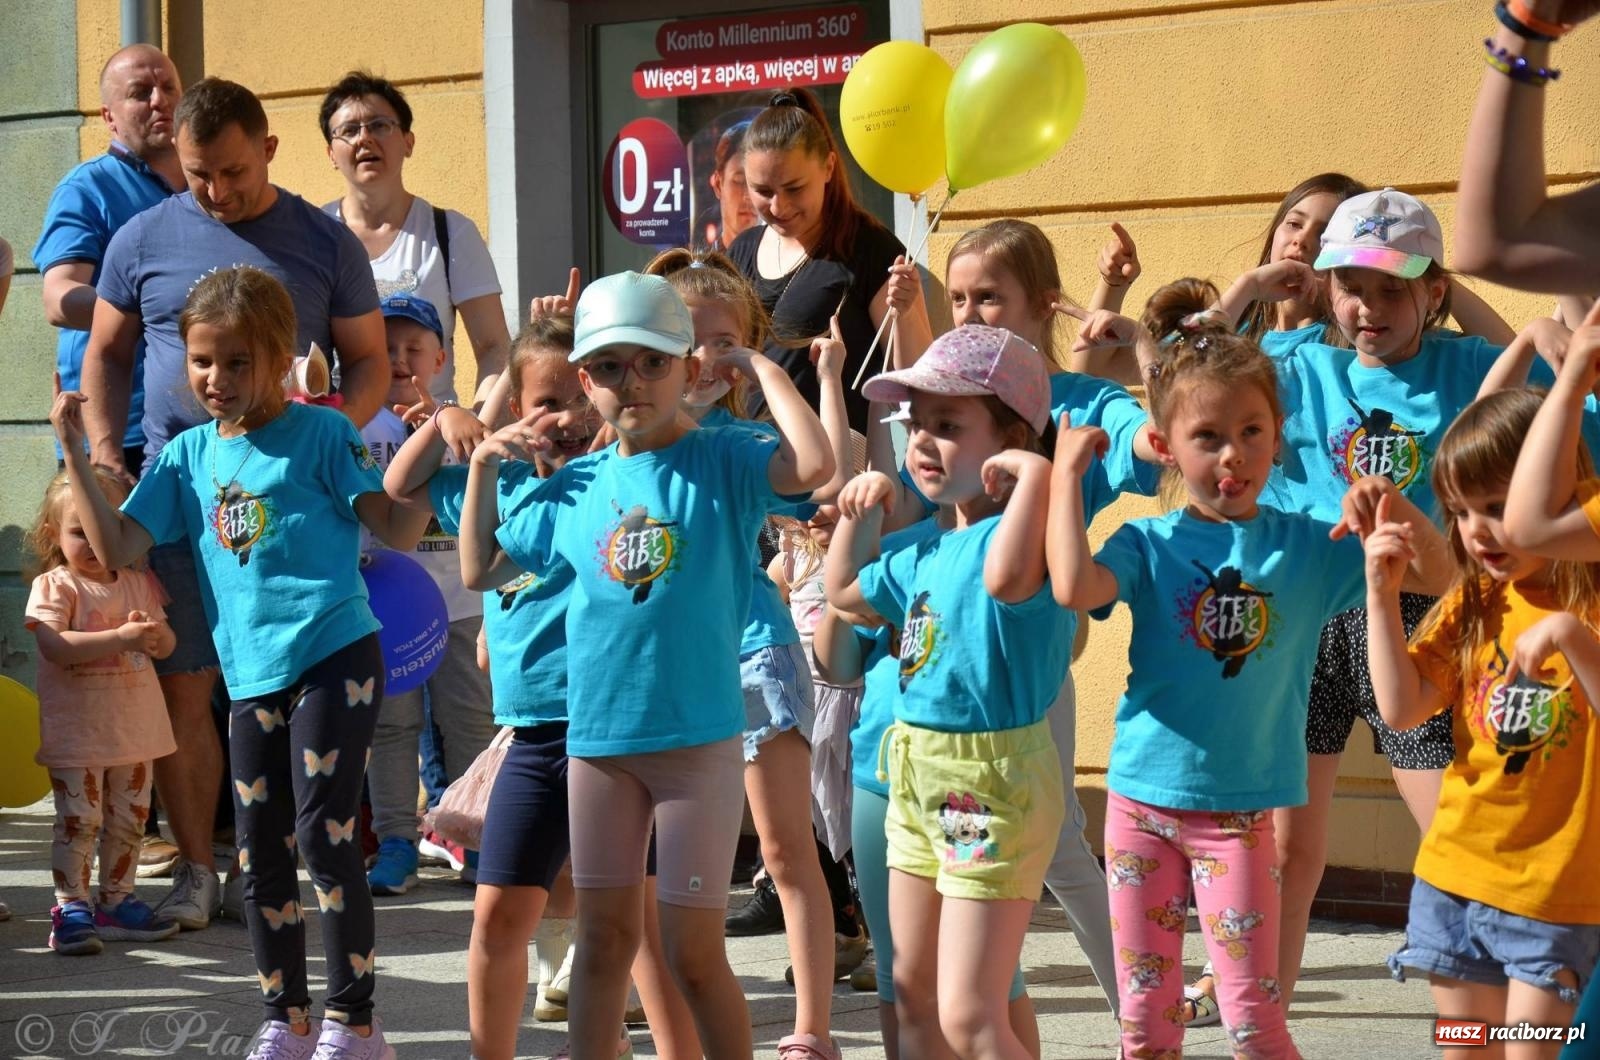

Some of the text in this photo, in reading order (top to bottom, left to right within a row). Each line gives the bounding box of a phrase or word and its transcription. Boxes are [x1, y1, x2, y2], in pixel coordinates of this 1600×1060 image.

[666, 12, 857, 52] Konto Millennium 360°
[643, 64, 698, 92] Więcej
[701, 67, 711, 84] z
[715, 60, 760, 86] apką,
[763, 54, 818, 82] więcej
[823, 57, 838, 74] w
[612, 137, 684, 214] 0 zł
[625, 217, 669, 229] za prowadzenie
[638, 229, 656, 237] konta
[1353, 434, 1409, 457] STEP
[1351, 454, 1411, 477] KIDS
[221, 499, 256, 523] STEP
[222, 516, 260, 540] KIDS
[614, 527, 663, 551] STEP
[612, 547, 665, 571] KIDS
[1201, 594, 1259, 618] STEP
[1199, 615, 1260, 640] KIDS
[1489, 684, 1552, 712] STEP
[1486, 707, 1549, 735] KIDS
